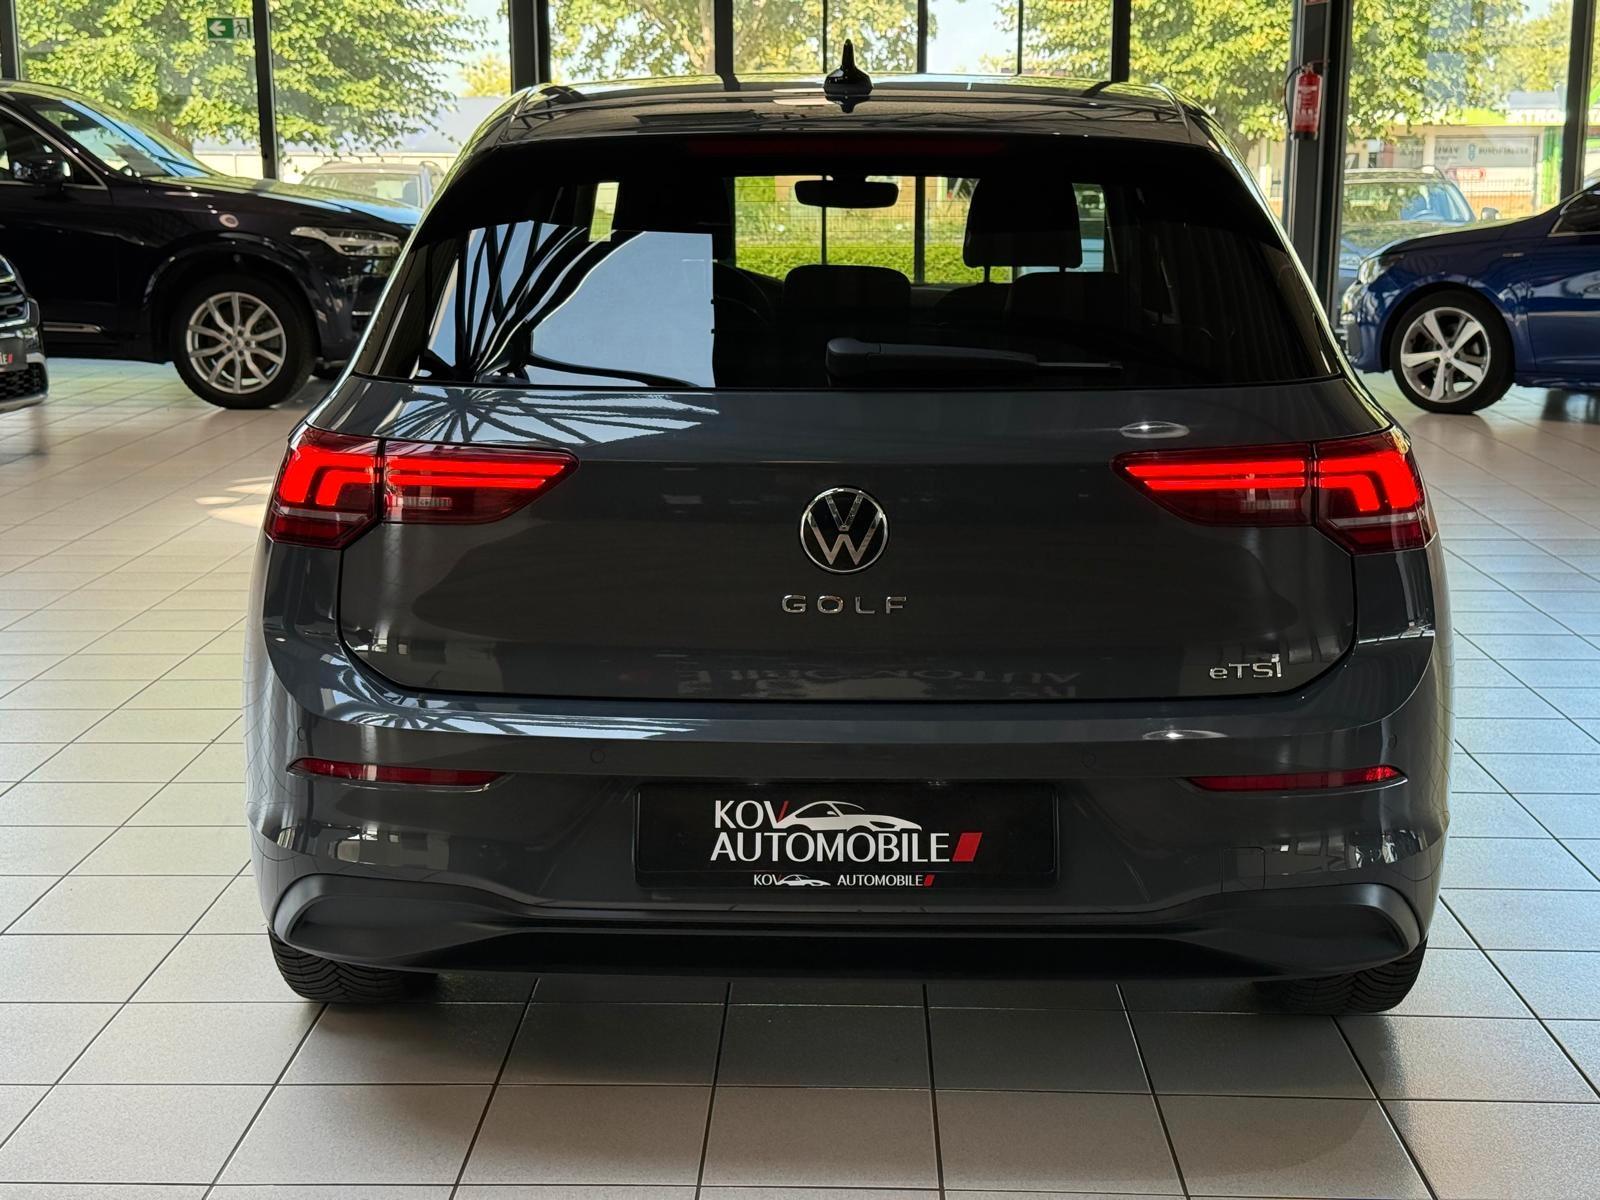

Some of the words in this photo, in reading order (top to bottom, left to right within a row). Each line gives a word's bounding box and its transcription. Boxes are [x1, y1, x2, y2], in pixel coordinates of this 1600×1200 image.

[803, 489, 886, 570] VW
[782, 594, 908, 614] GOLF
[714, 799, 789, 830] KOV
[710, 831, 950, 863] AUTOMOBILE
[753, 873, 782, 887] KOV
[836, 874, 924, 887] AUTOMOBILE
